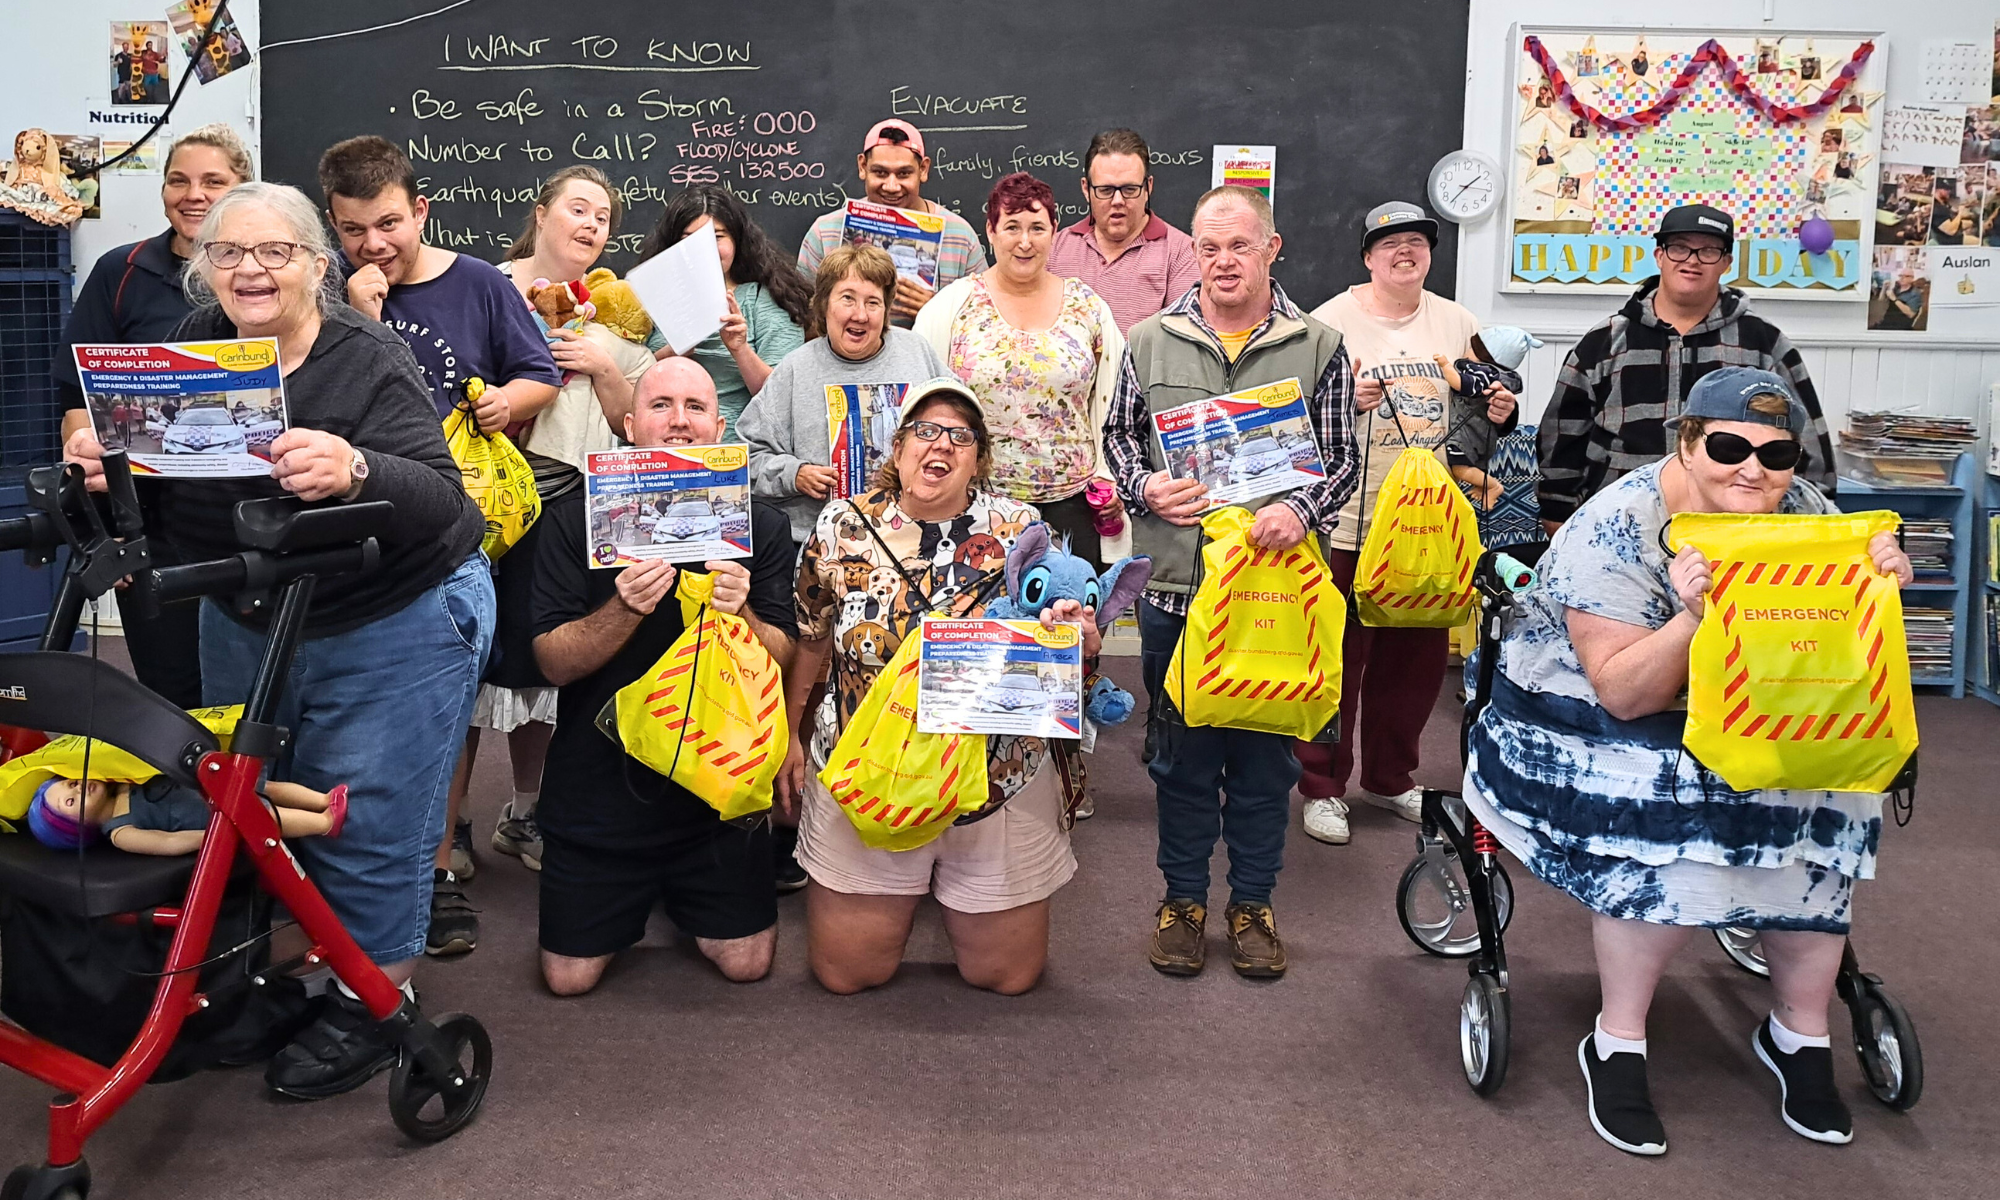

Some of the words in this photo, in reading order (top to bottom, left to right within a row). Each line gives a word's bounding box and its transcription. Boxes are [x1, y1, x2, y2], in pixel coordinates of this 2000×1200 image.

[444, 39, 450, 62] I
[467, 34, 550, 62] WANT
[571, 35, 618, 60] TO
[646, 38, 751, 64] KNOW
[890, 86, 1027, 115] EVACUATE
[411, 89, 463, 120] Be
[476, 88, 544, 125] safe
[562, 99, 589, 118] in
[607, 104, 625, 118] a
[637, 88, 736, 122] Storm
[408, 138, 508, 163] Number
[520, 140, 553, 162] to
[572, 133, 657, 161] Call?
[676, 138, 801, 163] FLOOD/CYCLONE
[1453, 162, 1461, 172] 11
[1463, 160, 1473, 171] 12
[668, 164, 720, 184] SES
[740, 160, 825, 181] 132500
[1443, 171, 1454, 181] 10
[1483, 170, 1490, 180] 2
[1440, 181, 1447, 191] 9
[1486, 182, 1493, 192] 3
[416, 175, 540, 218] Earthqua
[1442, 191, 1449, 202] 8
[1481, 194, 1488, 203] 4
[1461, 203, 1469, 213] 6
[1472, 199, 1480, 209] 5
[485, 230, 514, 250] is
[1521, 243, 1645, 273] HAPP
[1942, 255, 1991, 268] Auslan
[386, 320, 429, 336] SURF
[85, 348, 149, 357] CERTIFICATE
[88, 360, 102, 368] OF
[104, 360, 171, 369] COMPLETION
[434, 338, 456, 389] STORE
[175, 372, 229, 380] MANAGEMENT
[1165, 422, 1176, 430] OF
[611, 461, 668, 472] COMPLETION
[1232, 590, 1299, 604] EMERGENCY
[1744, 608, 1850, 622] EMERGENCY
[931, 622, 984, 630] CERTIFICATE
[1254, 618, 1276, 629] KIT
[1790, 640, 1818, 652] KIT
